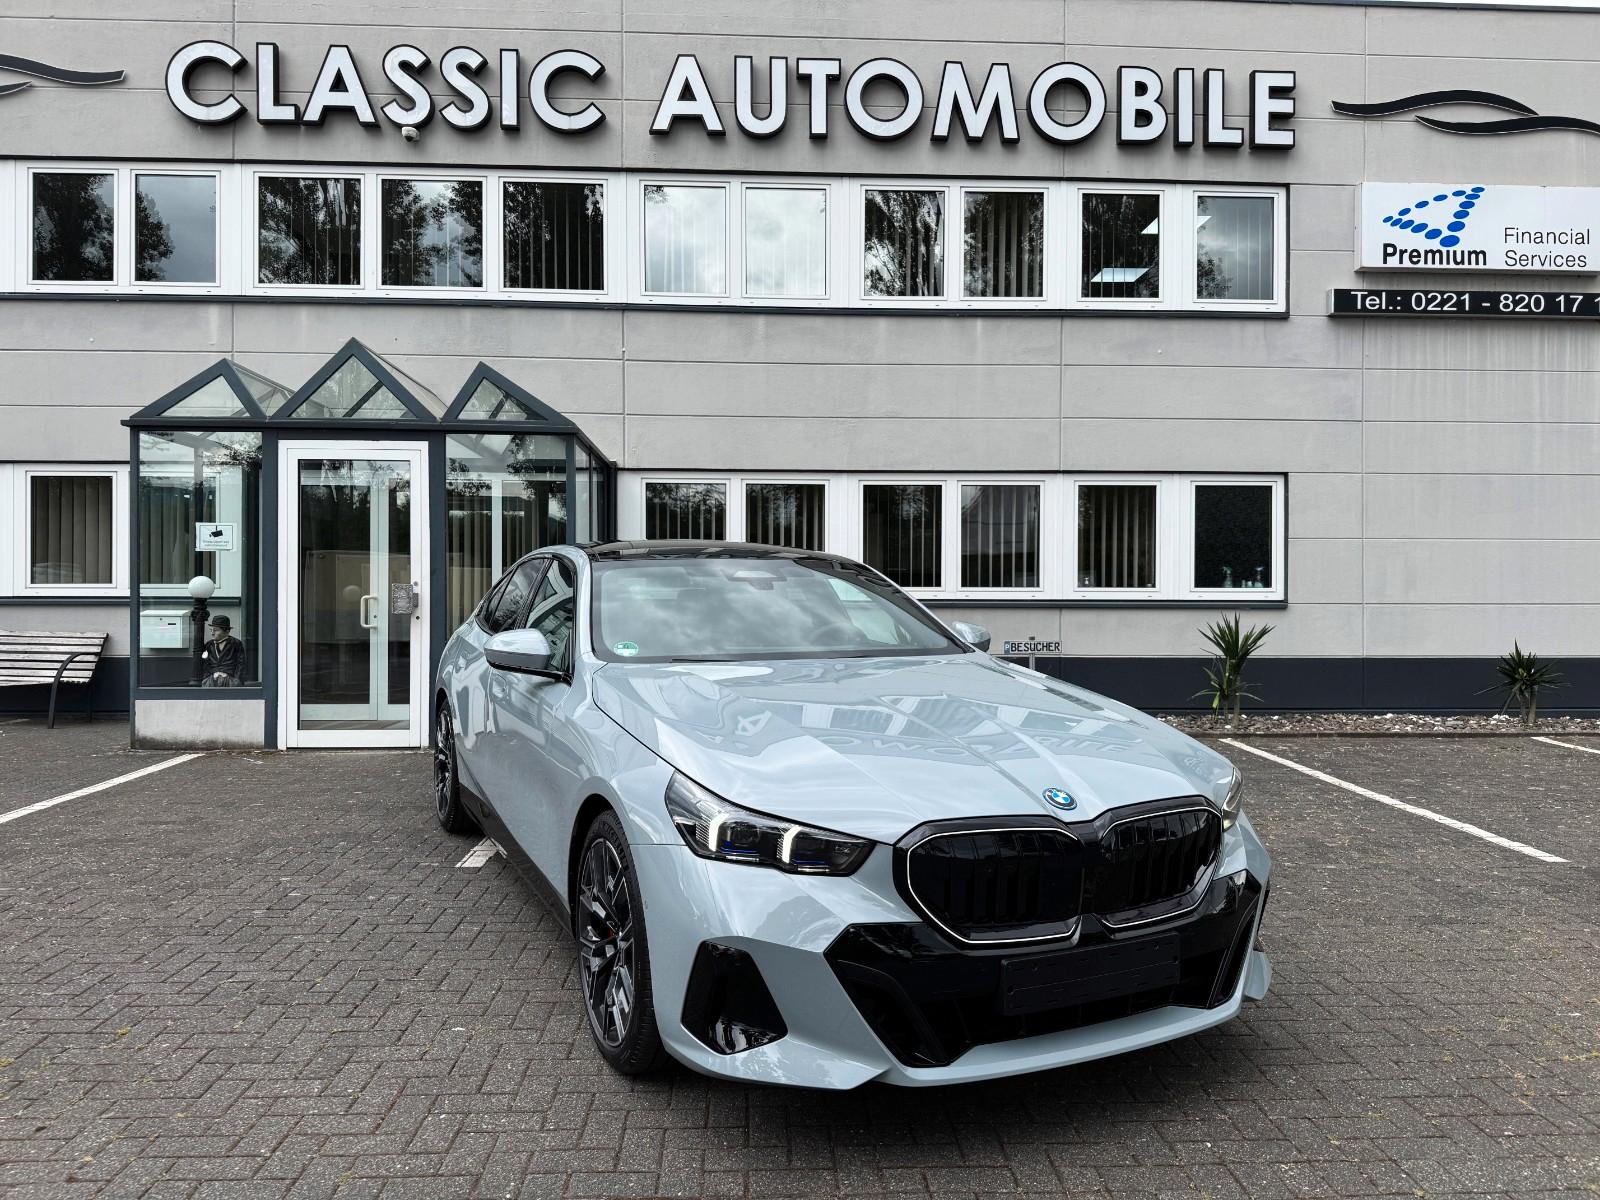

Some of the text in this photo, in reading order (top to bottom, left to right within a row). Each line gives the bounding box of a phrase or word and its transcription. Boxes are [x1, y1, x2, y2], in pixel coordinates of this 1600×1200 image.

[165, 40, 1296, 149] CLASSIC AUTOMOBILE
[1504, 228, 1590, 245] Financial
[1382, 243, 1487, 266] Premium
[1504, 250, 1587, 268] Services
[1351, 291, 1402, 310] Tel.:
[1411, 293, 1470, 311] 0221
[1499, 294, 1545, 312] 820
[1556, 295, 1584, 313] 17
[1011, 642, 1060, 652] BESUCHER
